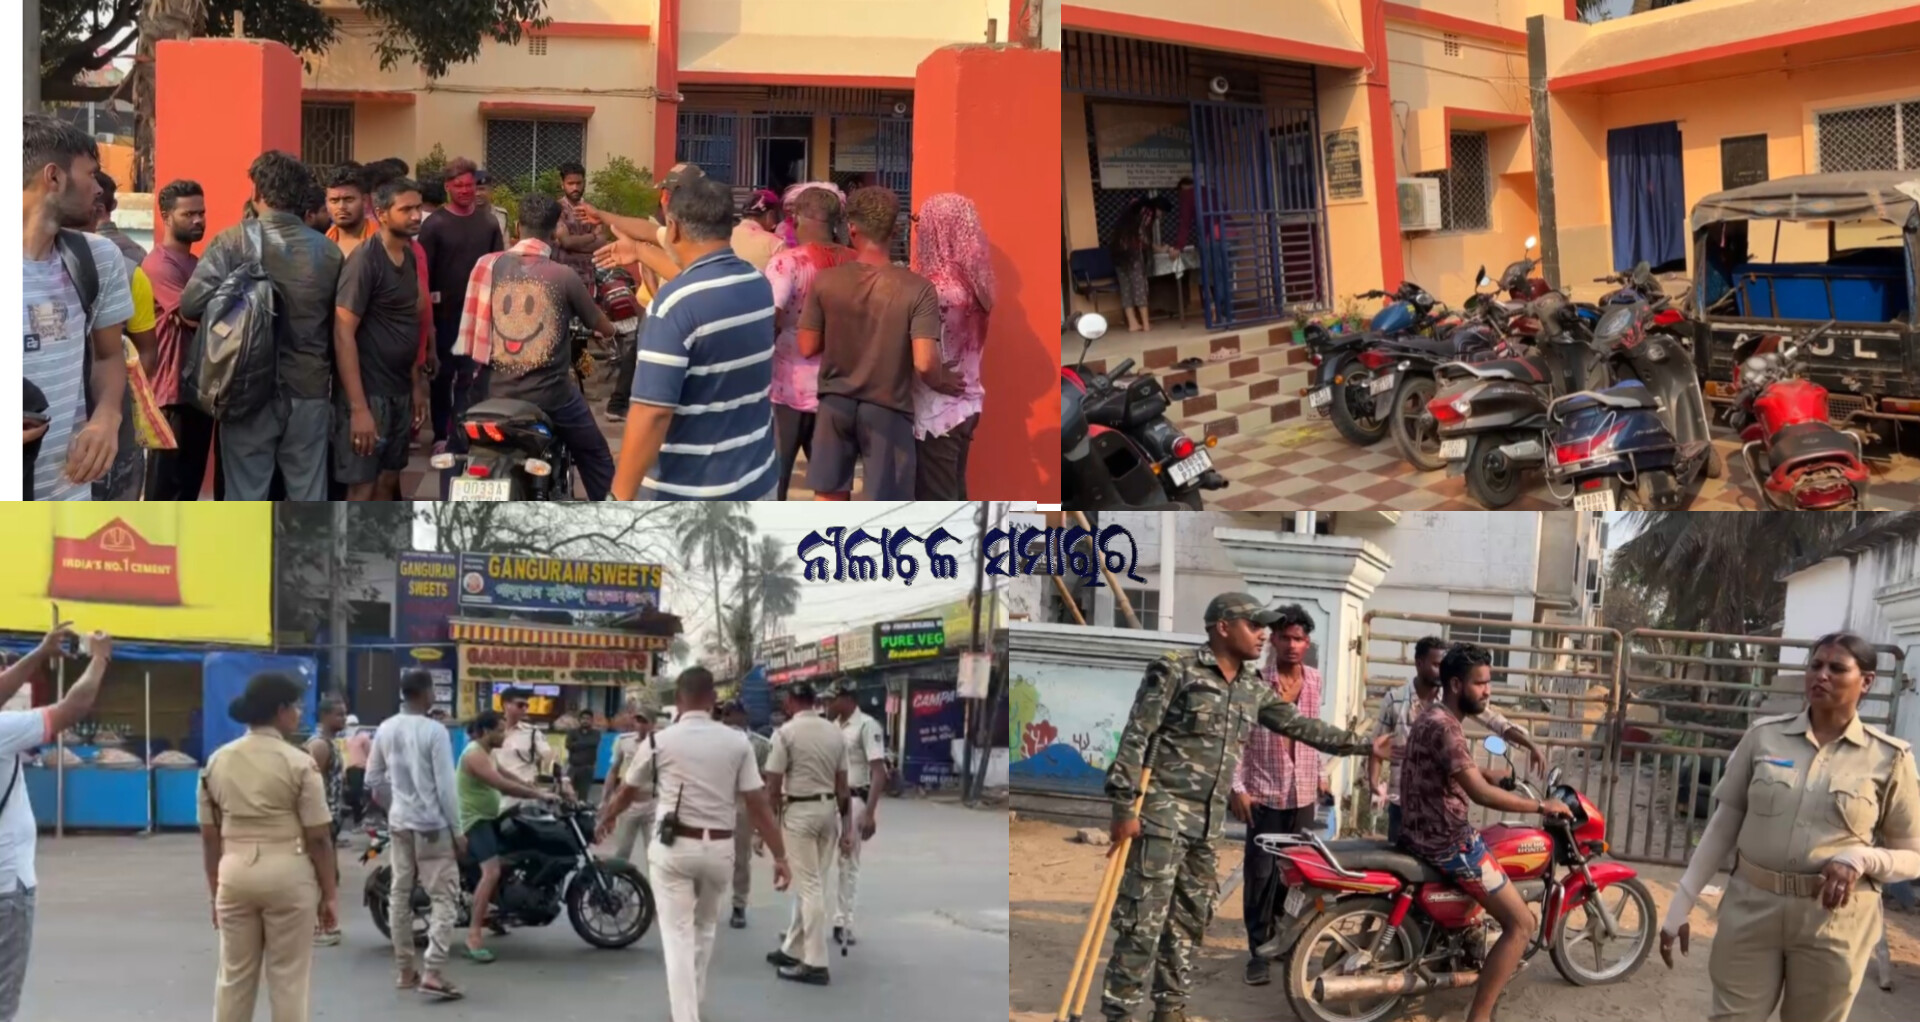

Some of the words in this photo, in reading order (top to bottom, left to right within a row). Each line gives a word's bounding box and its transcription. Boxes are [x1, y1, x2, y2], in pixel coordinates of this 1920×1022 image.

[62, 558, 102, 570] INDIA'S
[130, 562, 171, 574] CEMENT
[400, 561, 456, 579] GANGURAM
[488, 555, 588, 583] GANGURAM
[590, 562, 661, 588] SWEETS
[409, 580, 448, 597] SWEETS
[881, 636, 913, 648] PURE
[919, 632, 944, 646] VEG
[913, 690, 957, 708] CAMPA
